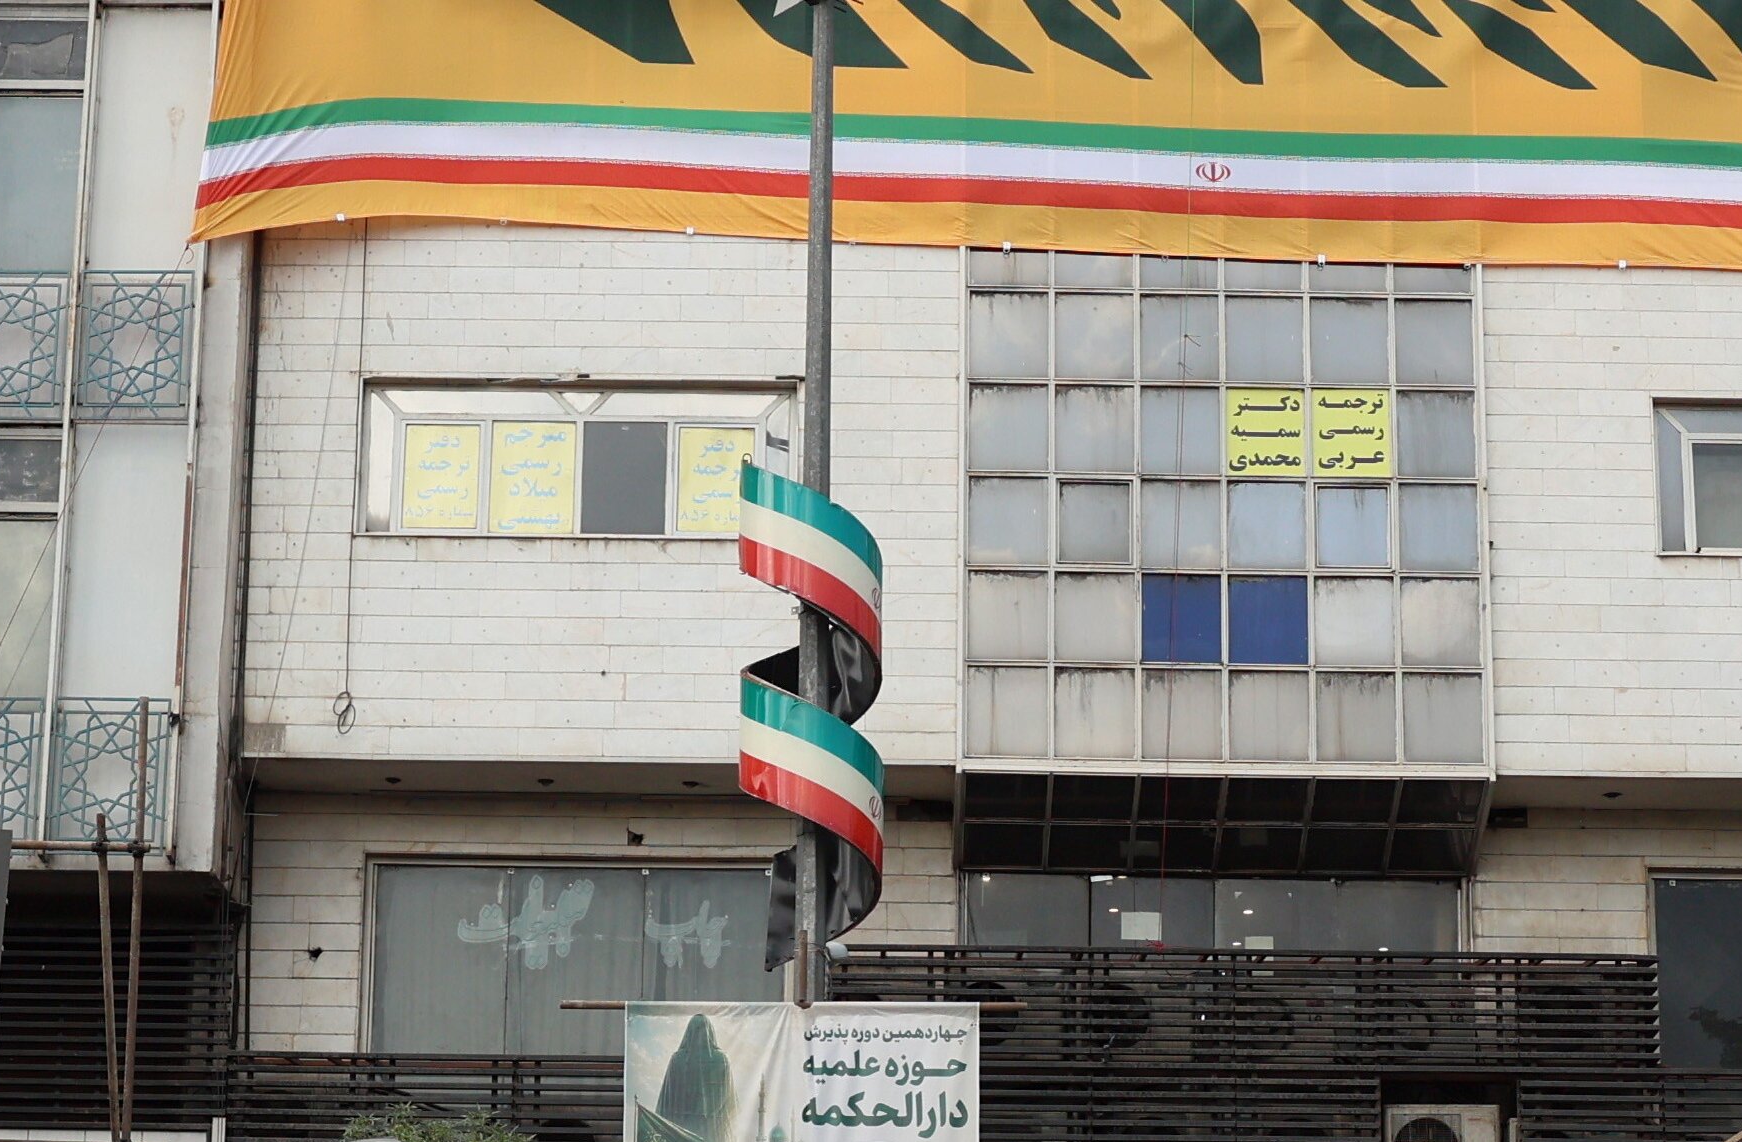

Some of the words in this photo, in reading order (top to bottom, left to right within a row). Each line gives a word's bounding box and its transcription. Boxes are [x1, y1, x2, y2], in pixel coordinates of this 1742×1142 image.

[1232, 395, 1300, 416] دکتر
[1317, 393, 1384, 415] ترجمه
[1230, 424, 1301, 442] سمیه
[1318, 424, 1385, 441] رسمی
[1228, 452, 1302, 472] محمدی
[1317, 450, 1385, 470] عربی
[803, 1022, 849, 1046] پذیرش
[851, 1025, 880, 1044] دوره
[882, 1024, 968, 1046] چهاردهمین
[802, 1048, 881, 1085] علمیه
[884, 1053, 968, 1086] حوزه
[801, 1090, 969, 1139] دارالحکمه
